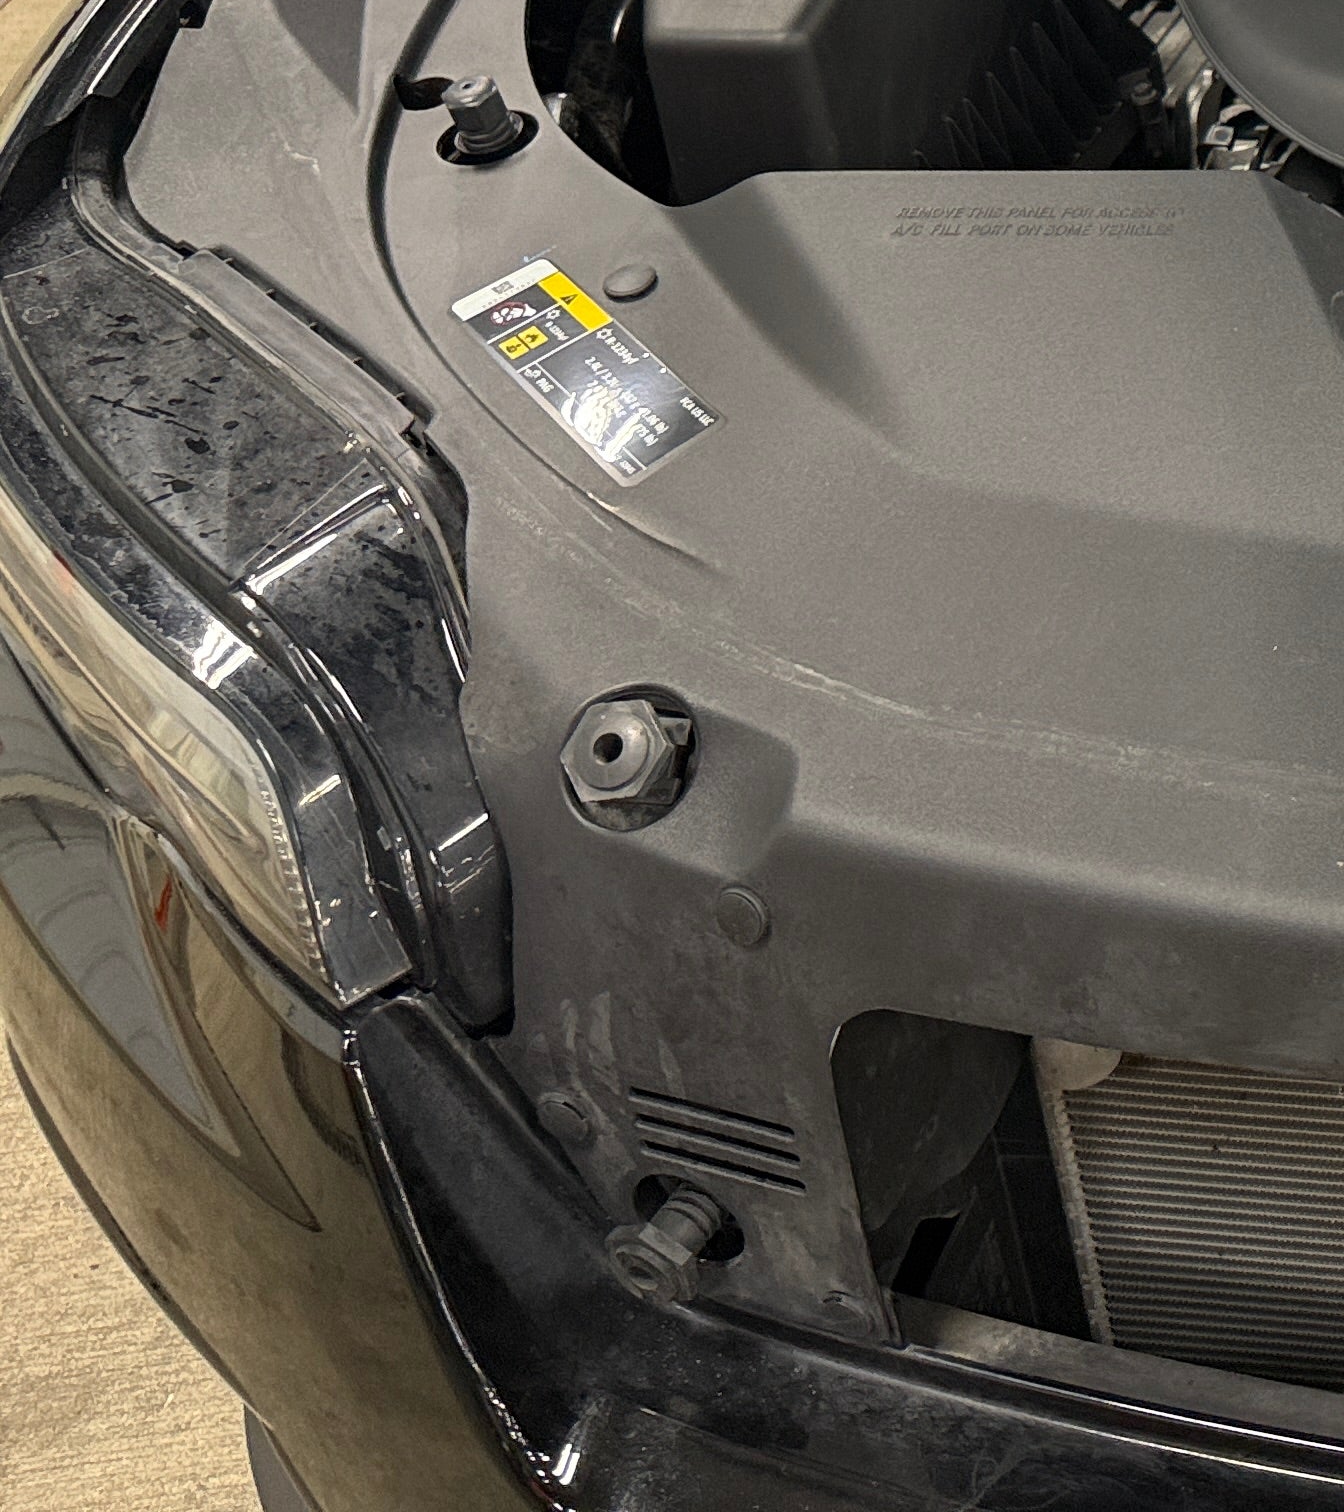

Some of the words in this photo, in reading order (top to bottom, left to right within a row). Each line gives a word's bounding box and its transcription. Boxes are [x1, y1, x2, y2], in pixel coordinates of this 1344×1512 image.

[896, 207, 963, 218] REMOVE
[967, 207, 1003, 218] THIS
[1006, 207, 1056, 219] PANEL
[1060, 207, 1092, 219] FOR
[890, 223, 923, 236] A/C
[928, 223, 961, 236] FILL
[966, 224, 1011, 237] PORT
[1015, 224, 1041, 236] ON
[1042, 225, 1092, 237] SOME
[1098, 224, 1174, 237] VEHICLES
